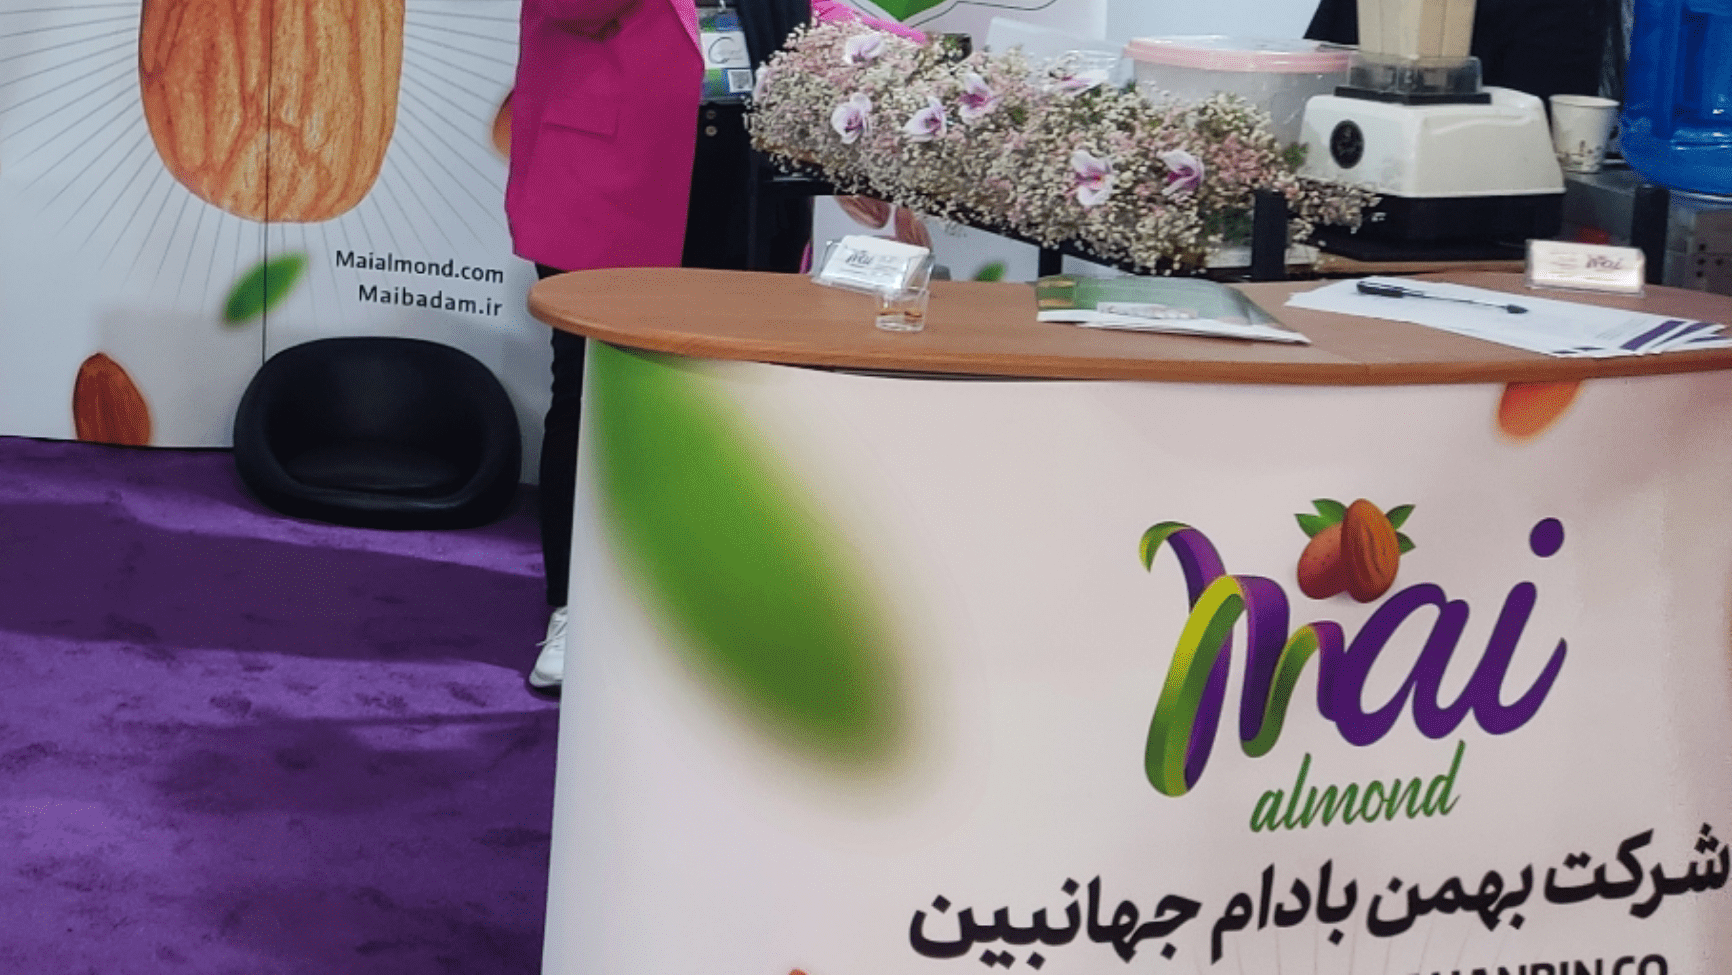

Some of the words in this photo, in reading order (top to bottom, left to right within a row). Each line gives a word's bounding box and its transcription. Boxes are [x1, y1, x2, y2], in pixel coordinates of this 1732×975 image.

[335, 249, 504, 284] Maialmond.com
[358, 284, 504, 316] Maibadam.ir
[1249, 739, 1466, 833] almond
[1210, 859, 1359, 964] بادام
[1366, 858, 1535, 938] بهمن
[1542, 822, 1732, 918] شرکت
[909, 875, 1201, 971] جهانبین
